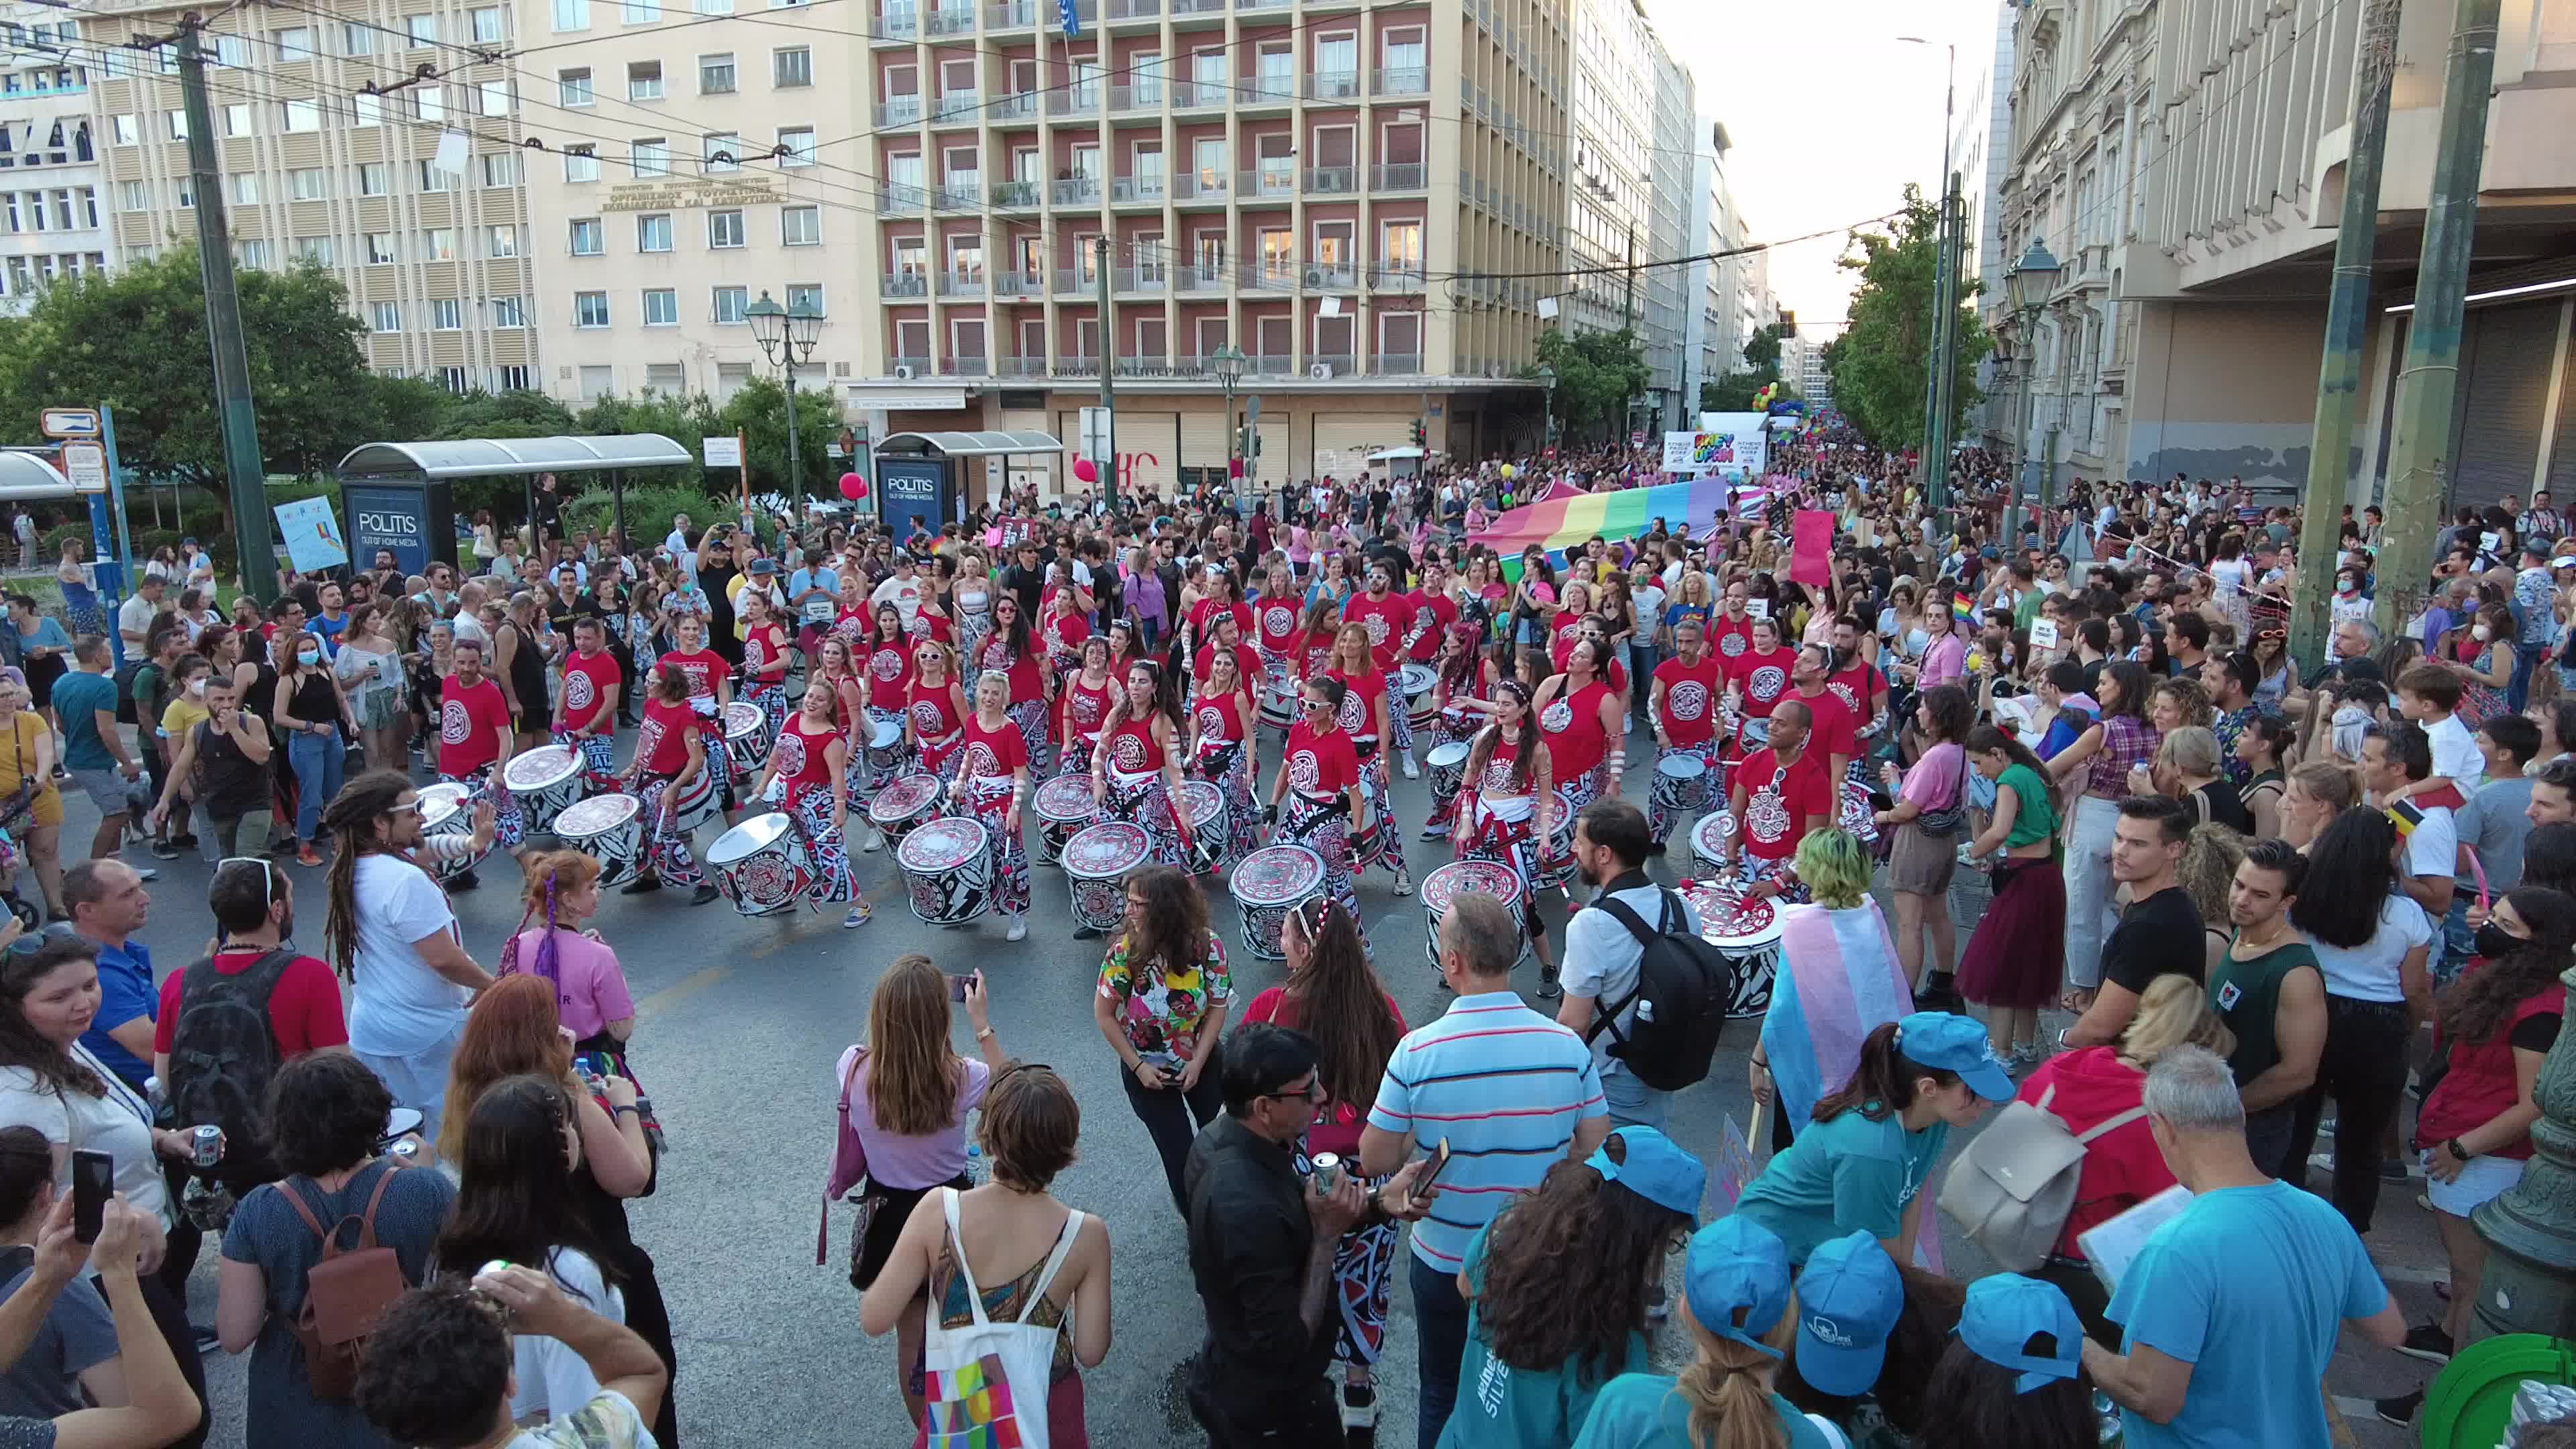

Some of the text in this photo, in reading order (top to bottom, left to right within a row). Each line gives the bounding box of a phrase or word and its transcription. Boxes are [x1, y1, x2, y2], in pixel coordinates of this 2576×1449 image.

[888, 478, 933, 492] POLITIS
[359, 513, 417, 533] POLITIS
[362, 536, 419, 547] OUT OF HOME MEDIA
[1485, 1360, 1509, 1419] SILVE
